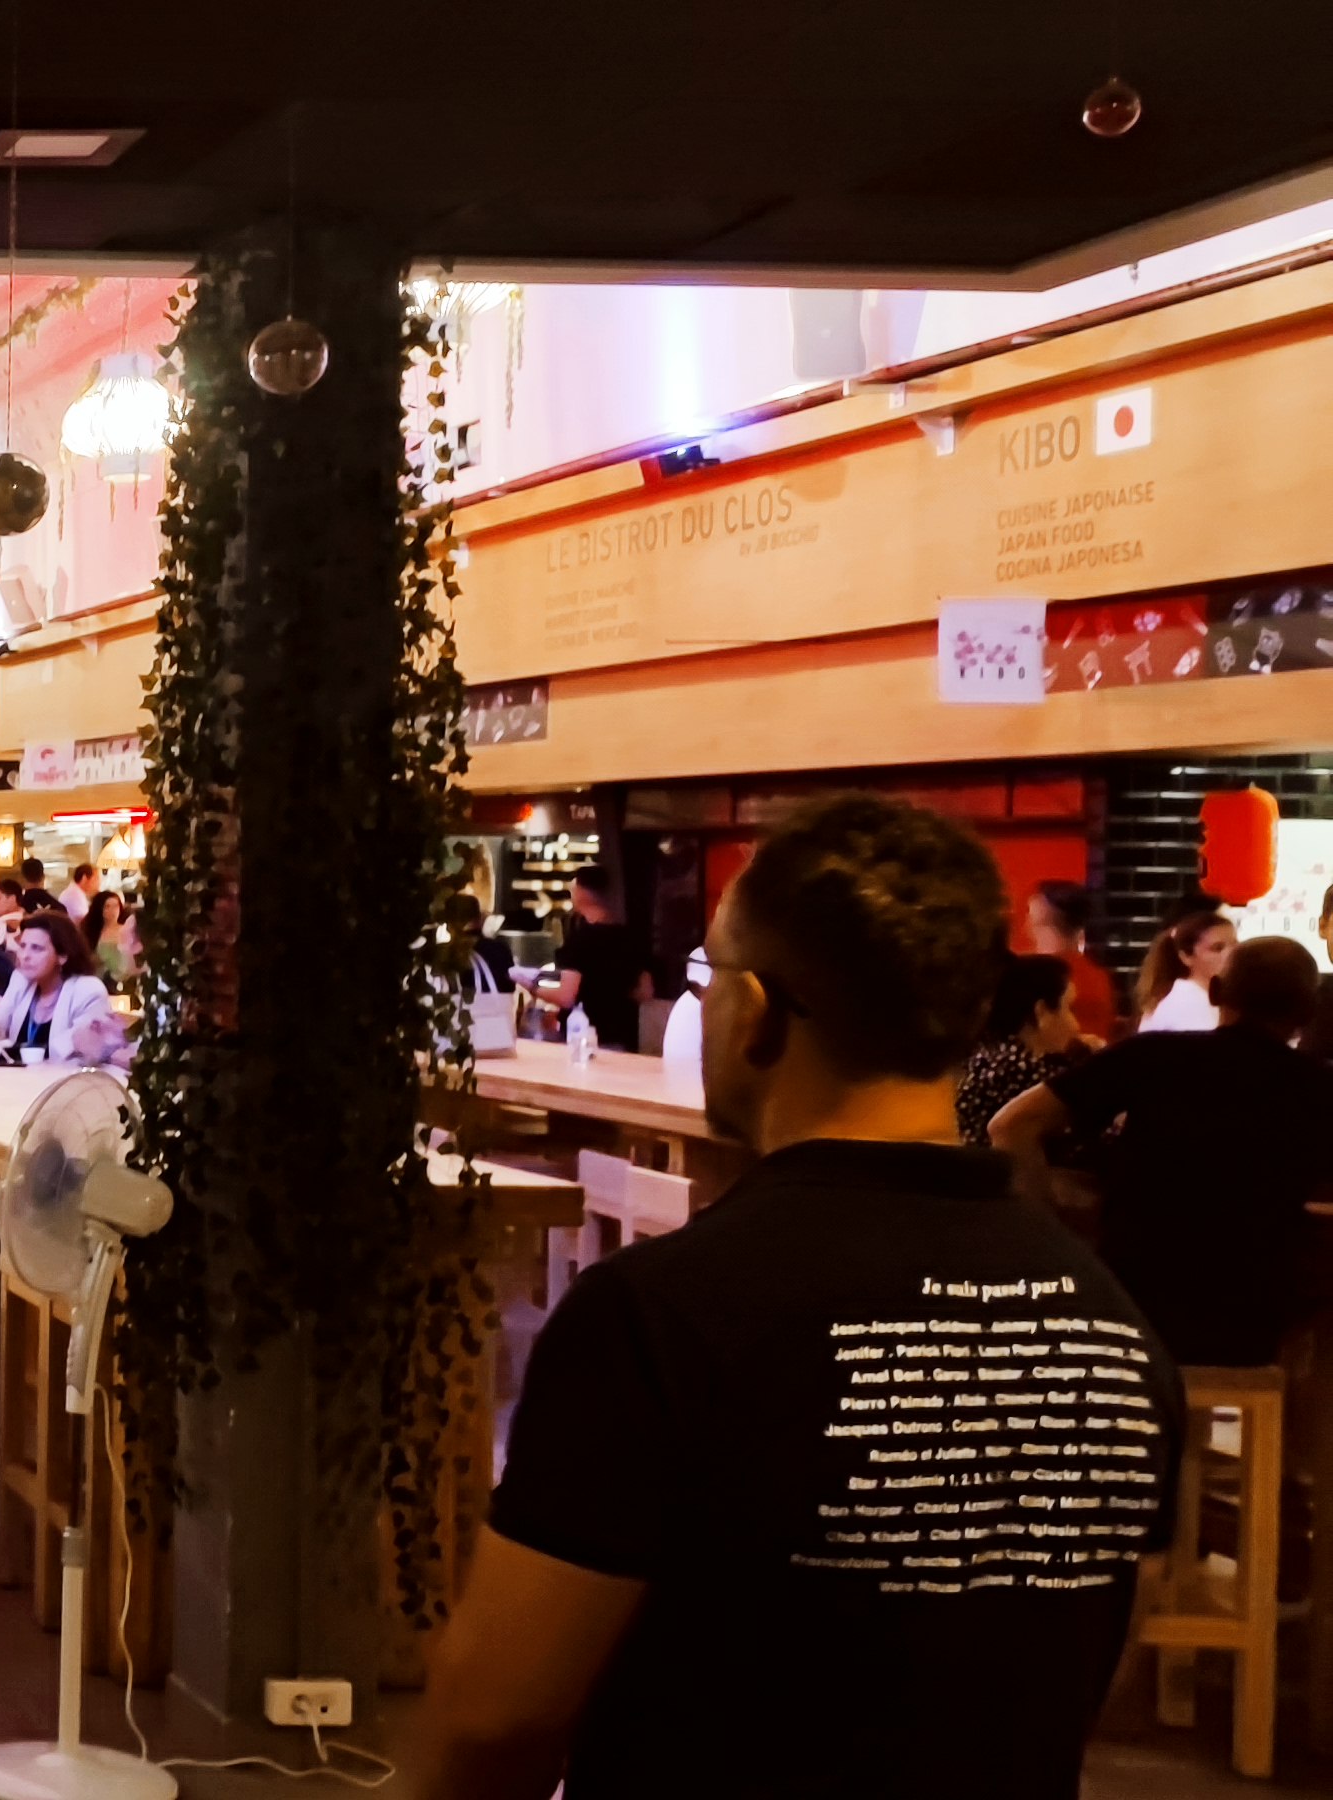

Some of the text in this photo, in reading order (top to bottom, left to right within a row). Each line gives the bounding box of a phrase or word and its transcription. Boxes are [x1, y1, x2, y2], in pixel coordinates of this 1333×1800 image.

[999, 416, 1081, 474] KIBO
[997, 480, 1155, 530] CUISINE JAPONAISE
[546, 485, 793, 573] LE BISTROT DU CLOS
[997, 520, 1095, 556] JAPAN FOOD
[996, 539, 1144, 582] COCINA JAPONESA
[960, 665, 1025, 679] KIBO
[922, 1277, 942, 1295] Je
[1031, 1281, 1059, 1300] par
